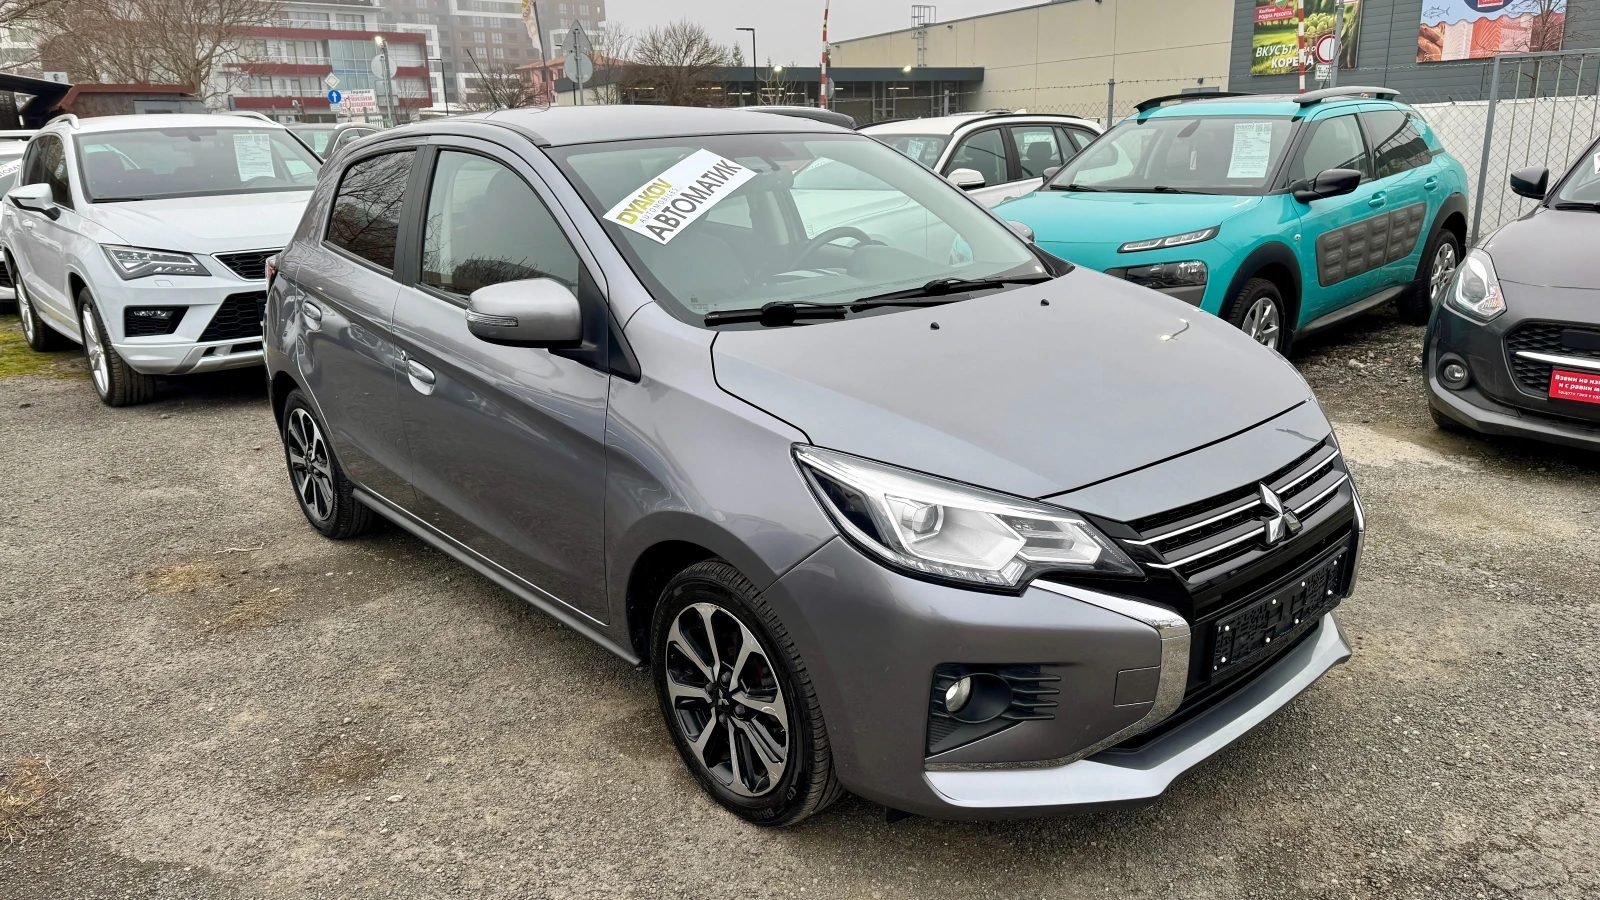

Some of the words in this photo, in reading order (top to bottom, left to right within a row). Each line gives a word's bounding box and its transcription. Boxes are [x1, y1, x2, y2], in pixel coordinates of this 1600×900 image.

[1255, 44, 1295, 57] ВКУСЪТ
[615, 177, 673, 225] DYAKOV
[639, 187, 679, 223] AUTOMOBILES
[645, 159, 742, 241] АВТОМАТИК
